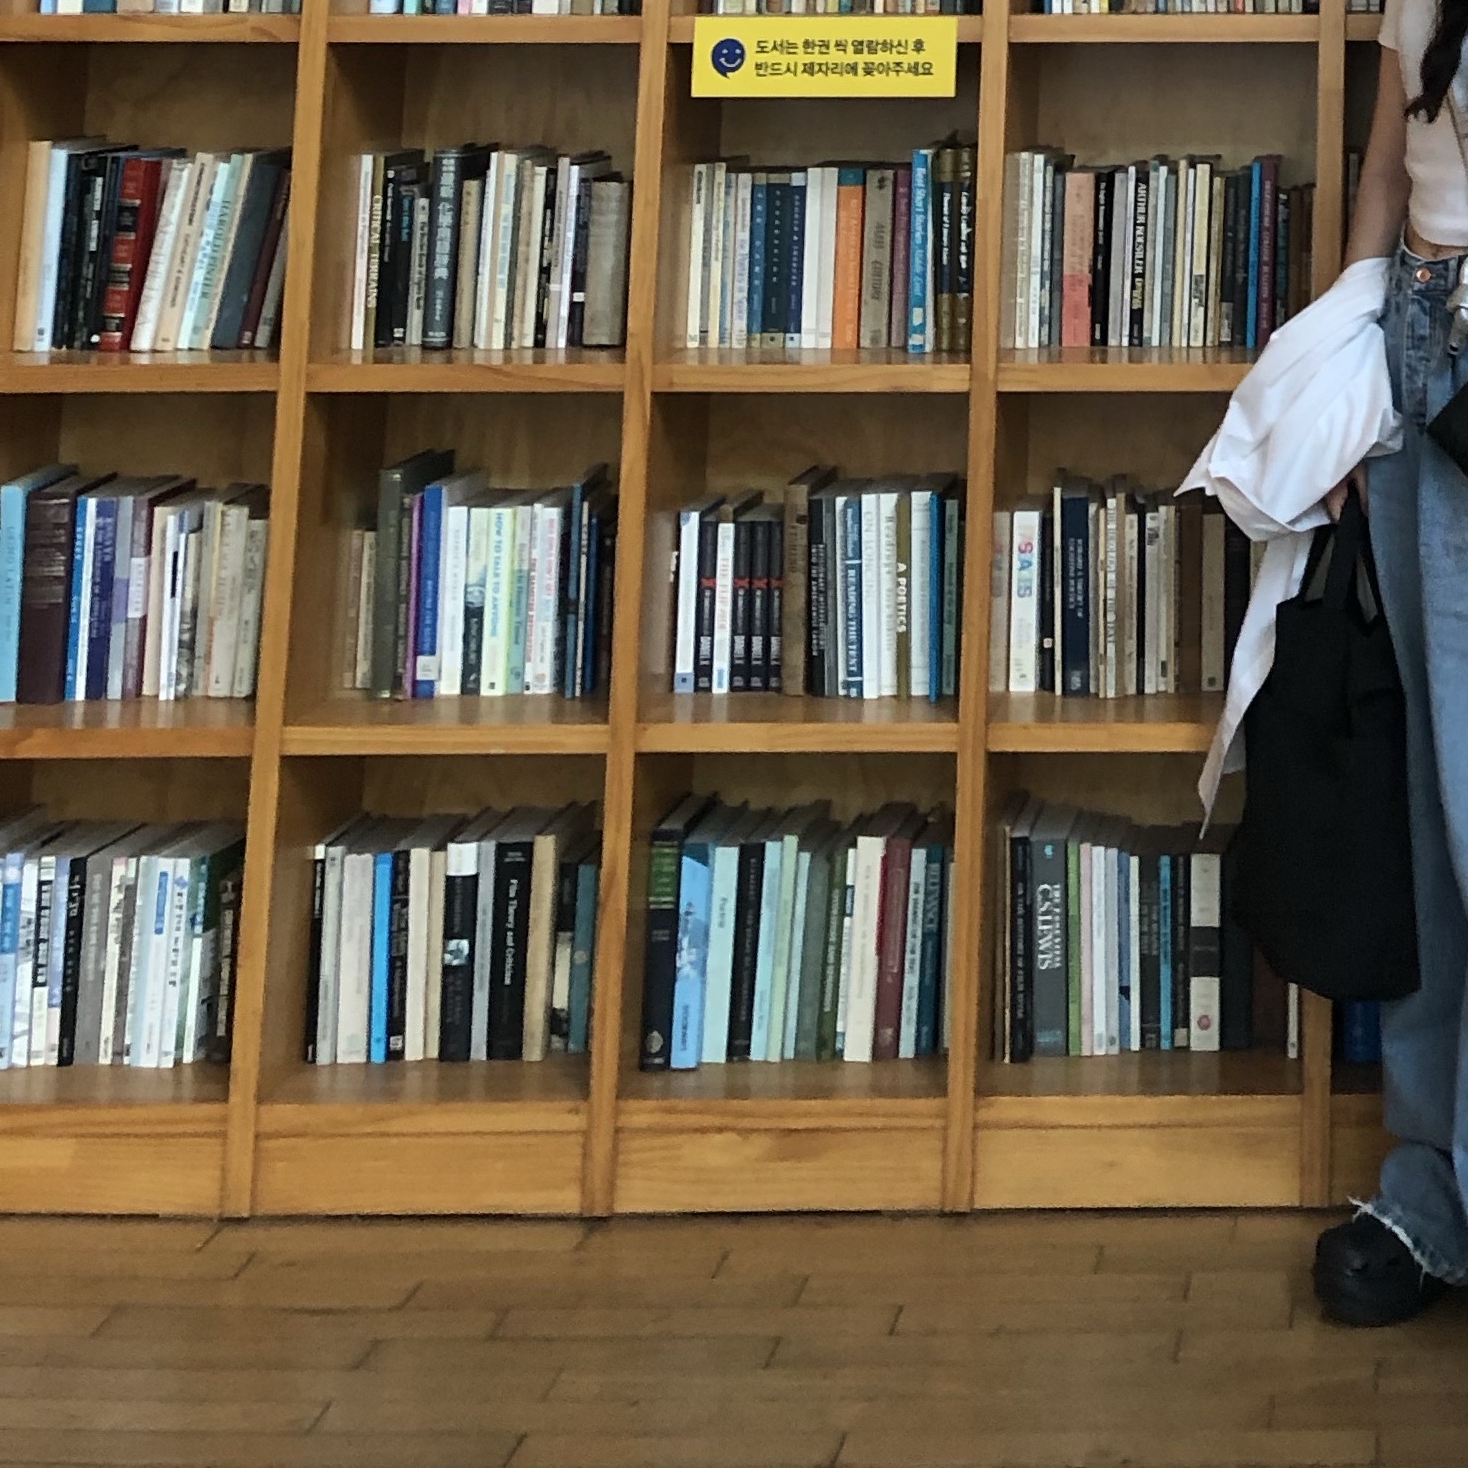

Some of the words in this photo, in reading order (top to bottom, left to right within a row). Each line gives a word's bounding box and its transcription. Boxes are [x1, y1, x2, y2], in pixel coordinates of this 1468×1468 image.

[756, 39, 798, 54] 도서는
[802, 39, 830, 54] 한권
[834, 40, 848, 54] 씩
[851, 39, 909, 54] 열람하신
[911, 39, 925, 54] 후
[755, 62, 797, 77] 반드시
[801, 62, 858, 77] 제자리에
[862, 62, 934, 77] 꽂아주세요
[1137, 183, 1147, 223] ARTHUR
[369, 196, 382, 246] CRITICAL
[1134, 226, 1145, 274] KOESTLER
[367, 254, 379, 308] TERRAINS
[897, 562, 906, 572] A
[847, 569, 856, 616] READING
[897, 577, 907, 633] POETICS
[847, 619, 856, 641] THE
[848, 643, 856, 671] TEXT
[509, 880, 518, 897] Film
[506, 901, 517, 928] Theory
[506, 931, 514, 946] and
[503, 948, 514, 985] Criticism
